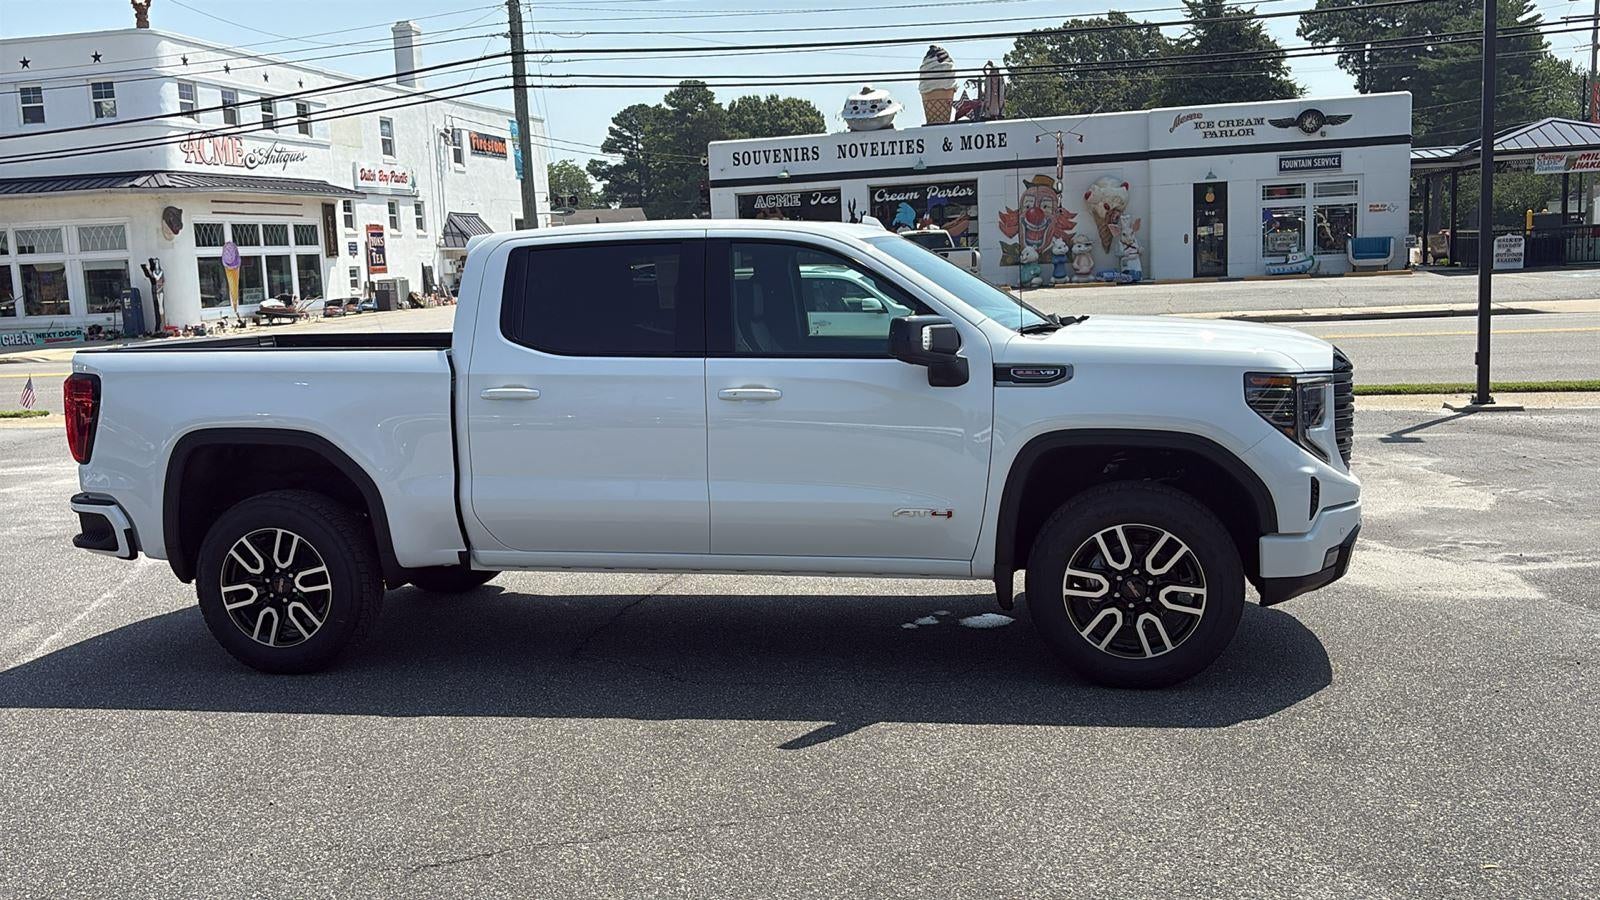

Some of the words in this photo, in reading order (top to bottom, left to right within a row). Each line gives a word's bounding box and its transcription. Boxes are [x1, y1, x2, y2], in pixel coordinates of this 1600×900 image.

[1193, 120, 1215, 130] ICE
[1217, 117, 1265, 128] CREAM
[1202, 128, 1255, 139] PARLOR
[470, 131, 507, 154] Firestone
[732, 145, 820, 167] SOUVENIRS
[836, 138, 925, 160] NOVELTIES
[942, 136, 953, 153] &
[960, 132, 1008, 151] MORE
[179, 131, 246, 168] ACME
[245, 141, 307, 171] Antiques
[1281, 158, 1312, 169] FOUNTAIN
[1313, 157, 1339, 167] SERVICE
[360, 167, 377, 182] Dutch
[378, 169, 390, 186] Boy
[390, 170, 409, 185] Paints
[754, 193, 801, 209] ACME
[810, 191, 838, 206] Ice
[874, 187, 920, 203] Cream
[926, 183, 975, 199] Parlor
[371, 252, 385, 264] TEA
[36, 331, 57, 339] NEXT
[893, 507, 953, 519] AT4
